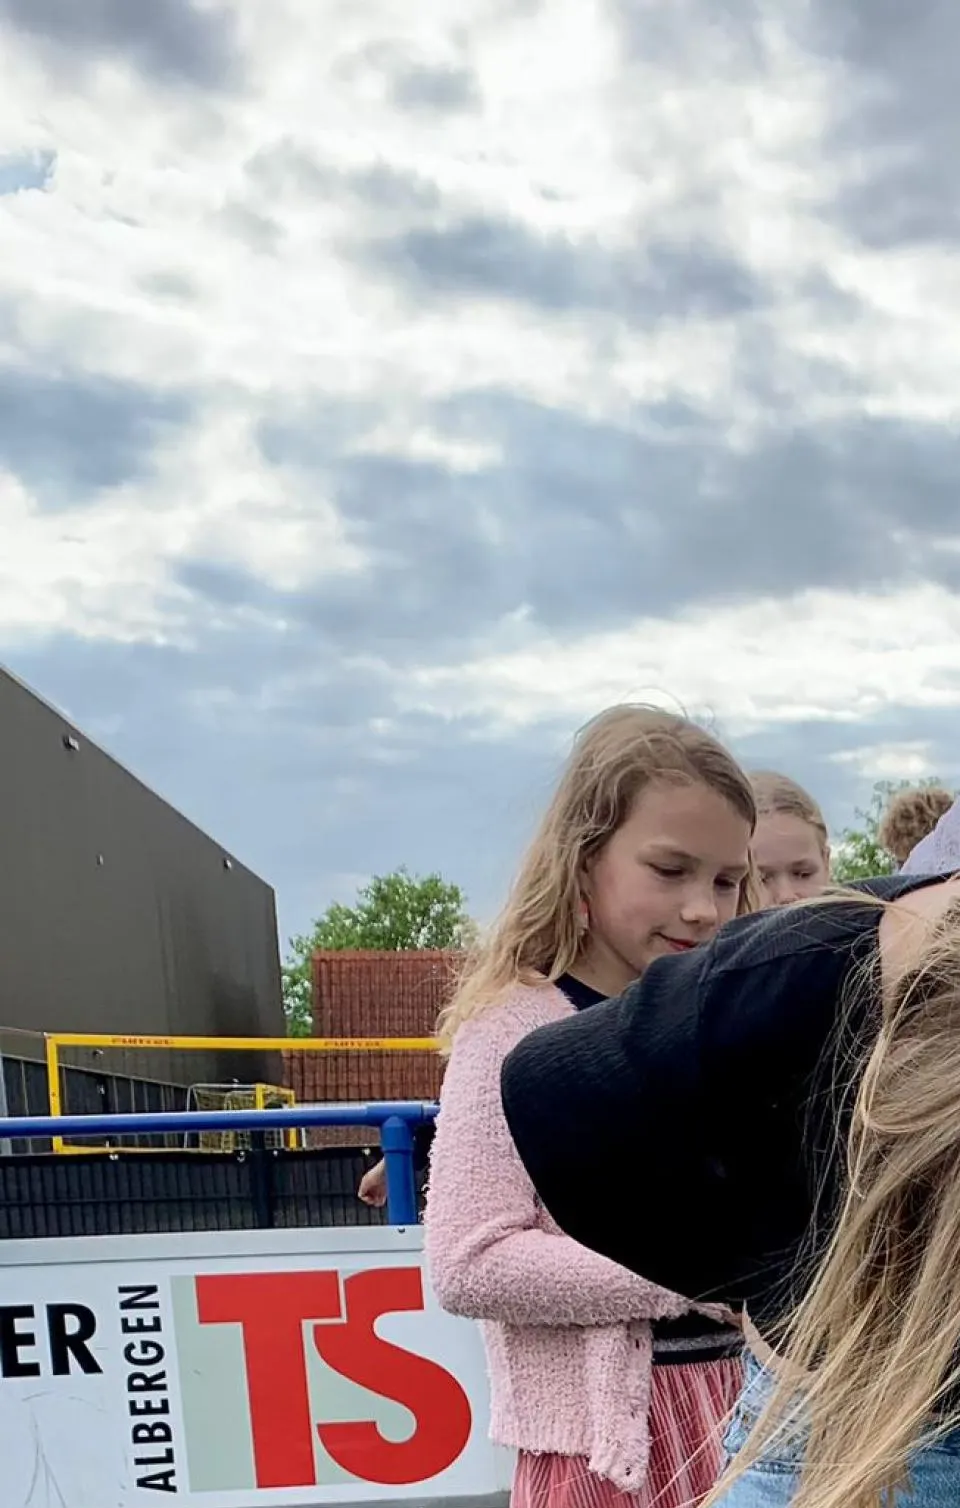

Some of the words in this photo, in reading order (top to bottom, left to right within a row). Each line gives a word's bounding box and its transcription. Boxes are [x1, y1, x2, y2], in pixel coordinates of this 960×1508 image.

[0, 1302, 104, 1379] ER
[117, 1284, 178, 1494] ALBERGEN
[194, 1265, 472, 1489] TS
